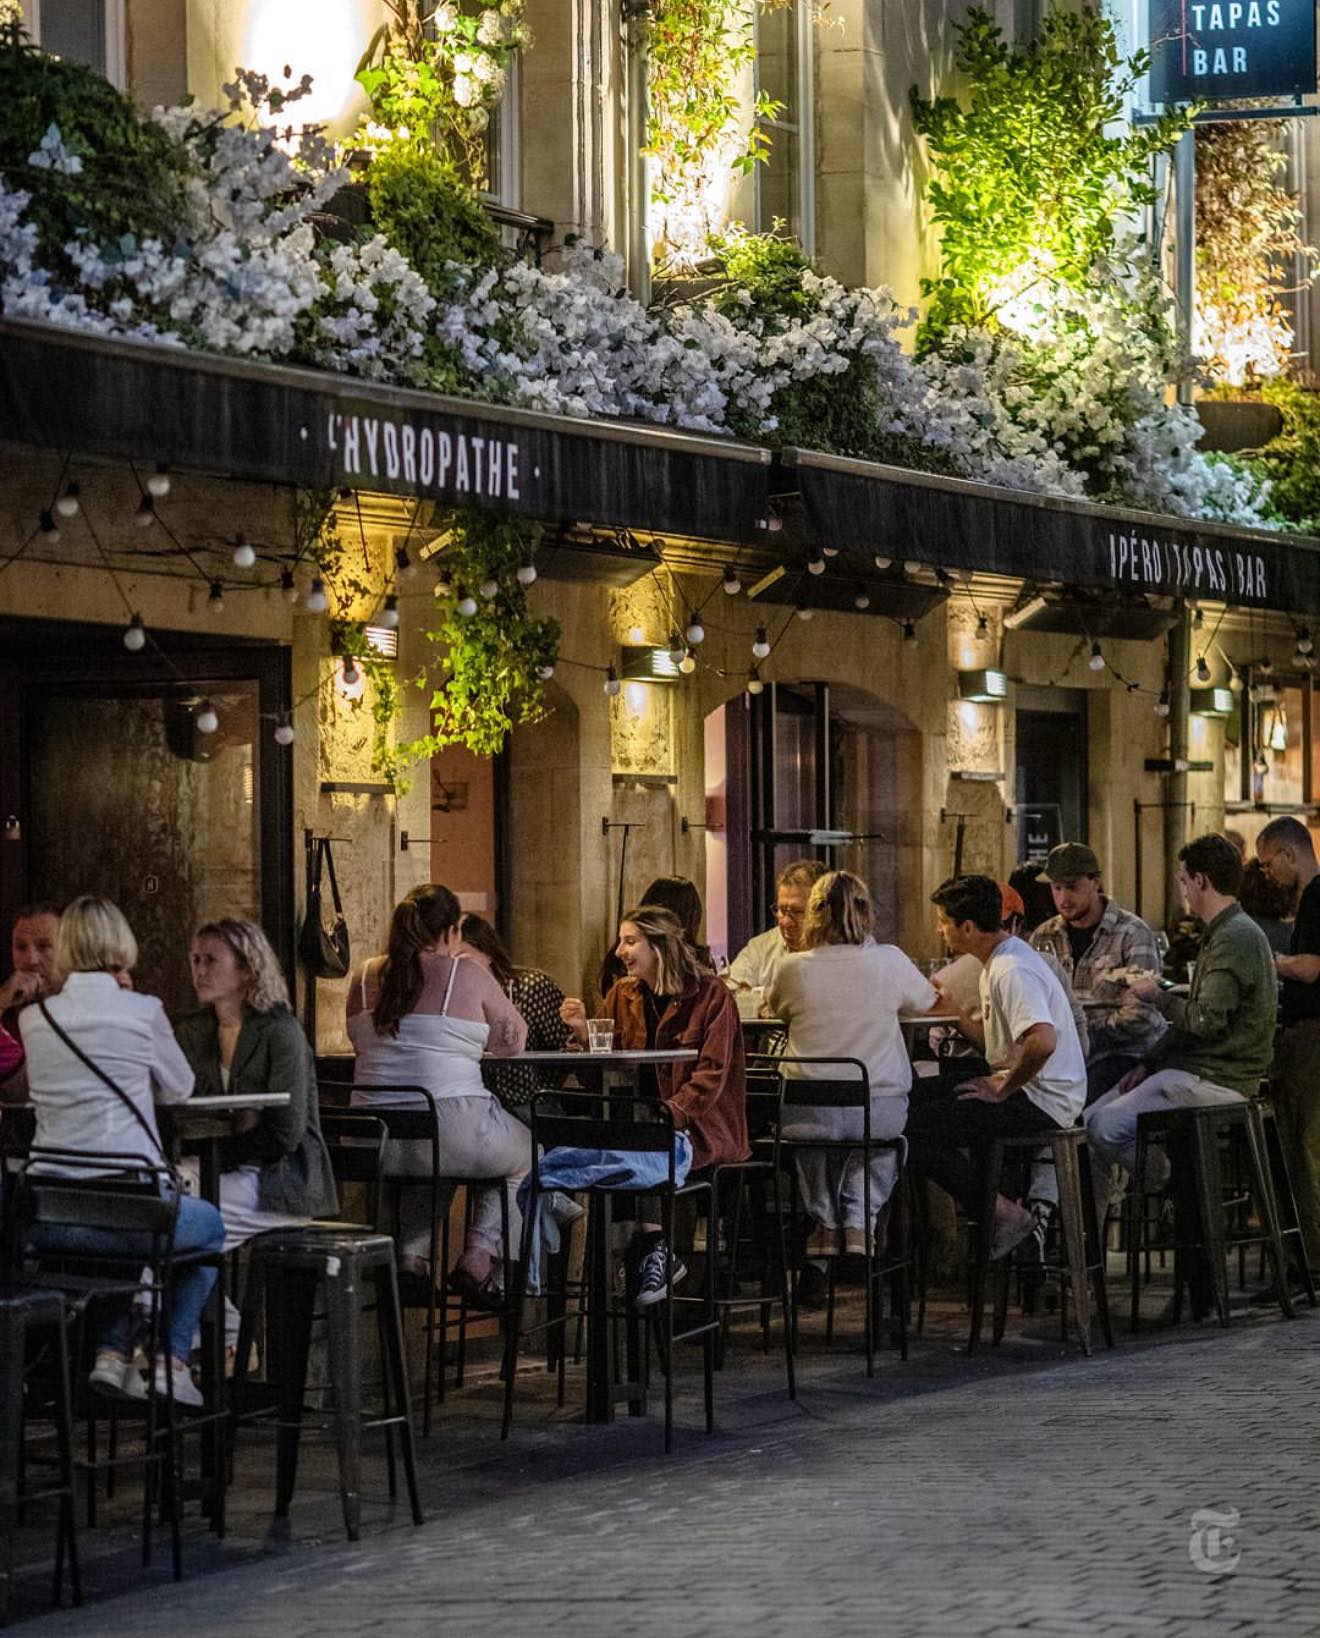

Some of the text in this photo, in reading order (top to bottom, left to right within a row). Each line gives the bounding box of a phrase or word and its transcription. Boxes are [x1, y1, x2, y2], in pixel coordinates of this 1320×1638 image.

[1192, 0, 1280, 31] TAPAS
[1193, 46, 1248, 76] BAR
[1235, 552, 1267, 599] BAR
